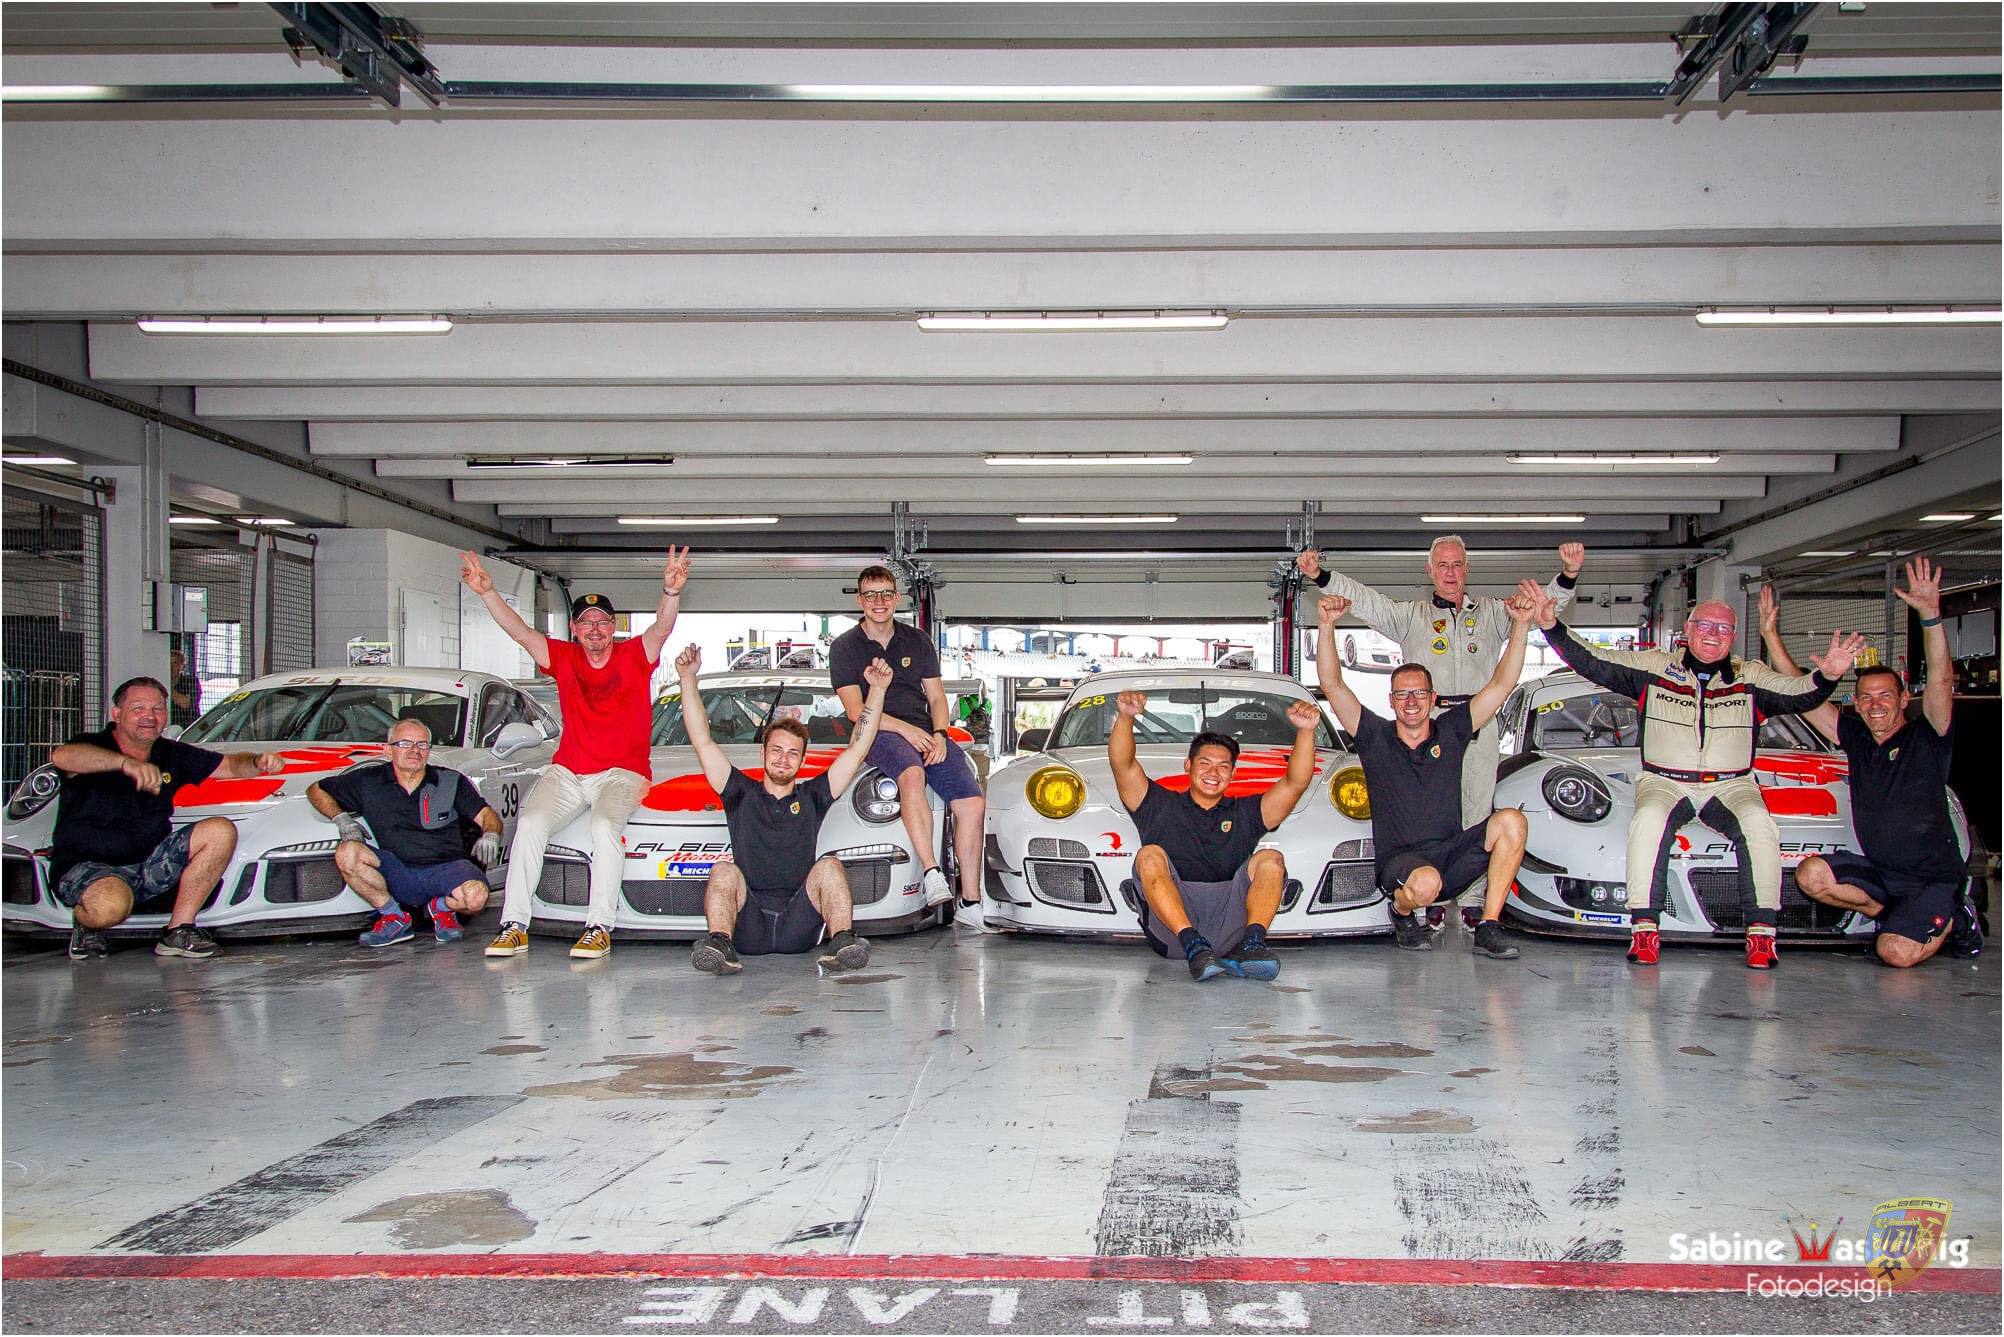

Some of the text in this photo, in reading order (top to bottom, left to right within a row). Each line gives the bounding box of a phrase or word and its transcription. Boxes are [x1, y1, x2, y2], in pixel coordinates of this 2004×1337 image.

[1078, 695, 1106, 709] 28
[1537, 700, 1565, 715] 50
[501, 783, 519, 818] 39
[621, 1286, 1311, 1328] PIT LANE
